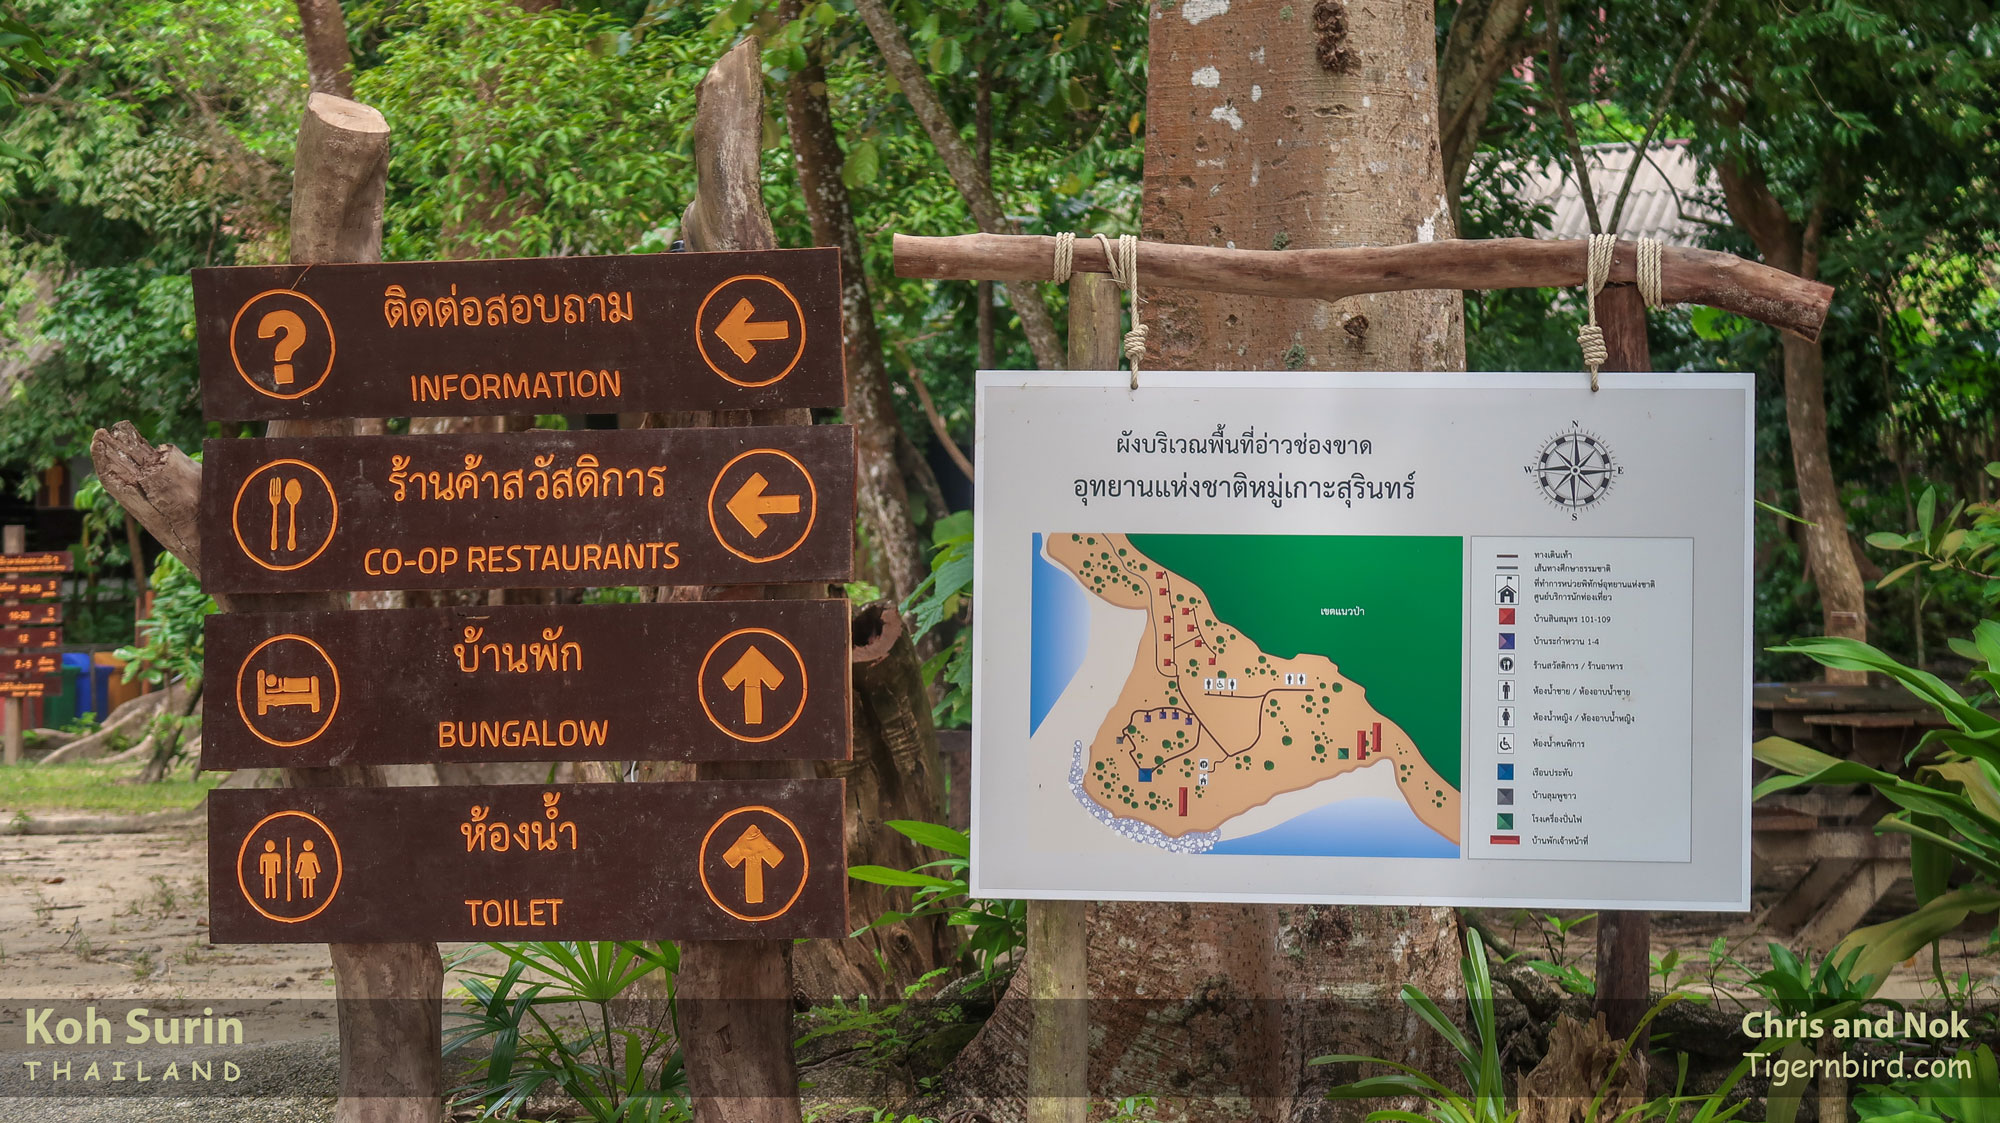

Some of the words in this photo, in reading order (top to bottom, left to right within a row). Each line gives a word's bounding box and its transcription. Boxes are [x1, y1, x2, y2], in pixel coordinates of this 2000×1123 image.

[384, 284, 634, 328] ติดต่อสอบถาม
[411, 370, 622, 402] INFORMATION
[1571, 419, 1579, 429] N
[1116, 423, 1373, 455] ผังบริเวณพื้นที่อ่าวช่องขาด
[389, 454, 668, 502] ร้านค้าสวัสดิการ
[1523, 465, 1534, 475] W
[1617, 466, 1625, 475] E
[1073, 470, 1417, 509] อุทยานแห่งชาติหมู่เกาะสุรินทร์
[1571, 512, 1578, 522] S
[364, 547, 459, 576] CO-OP
[468, 542, 681, 573] RESTAURANTS
[1320, 606, 1365, 616] เขตแนวป่า
[1581, 615, 1612, 624] 101-109
[454, 626, 583, 673] บ้านพัก
[1587, 638, 1600, 646] 1-4
[439, 720, 609, 748] BUNGALOW
[460, 792, 578, 852] ห้องน้ำ
[465, 899, 564, 927] TOILET
